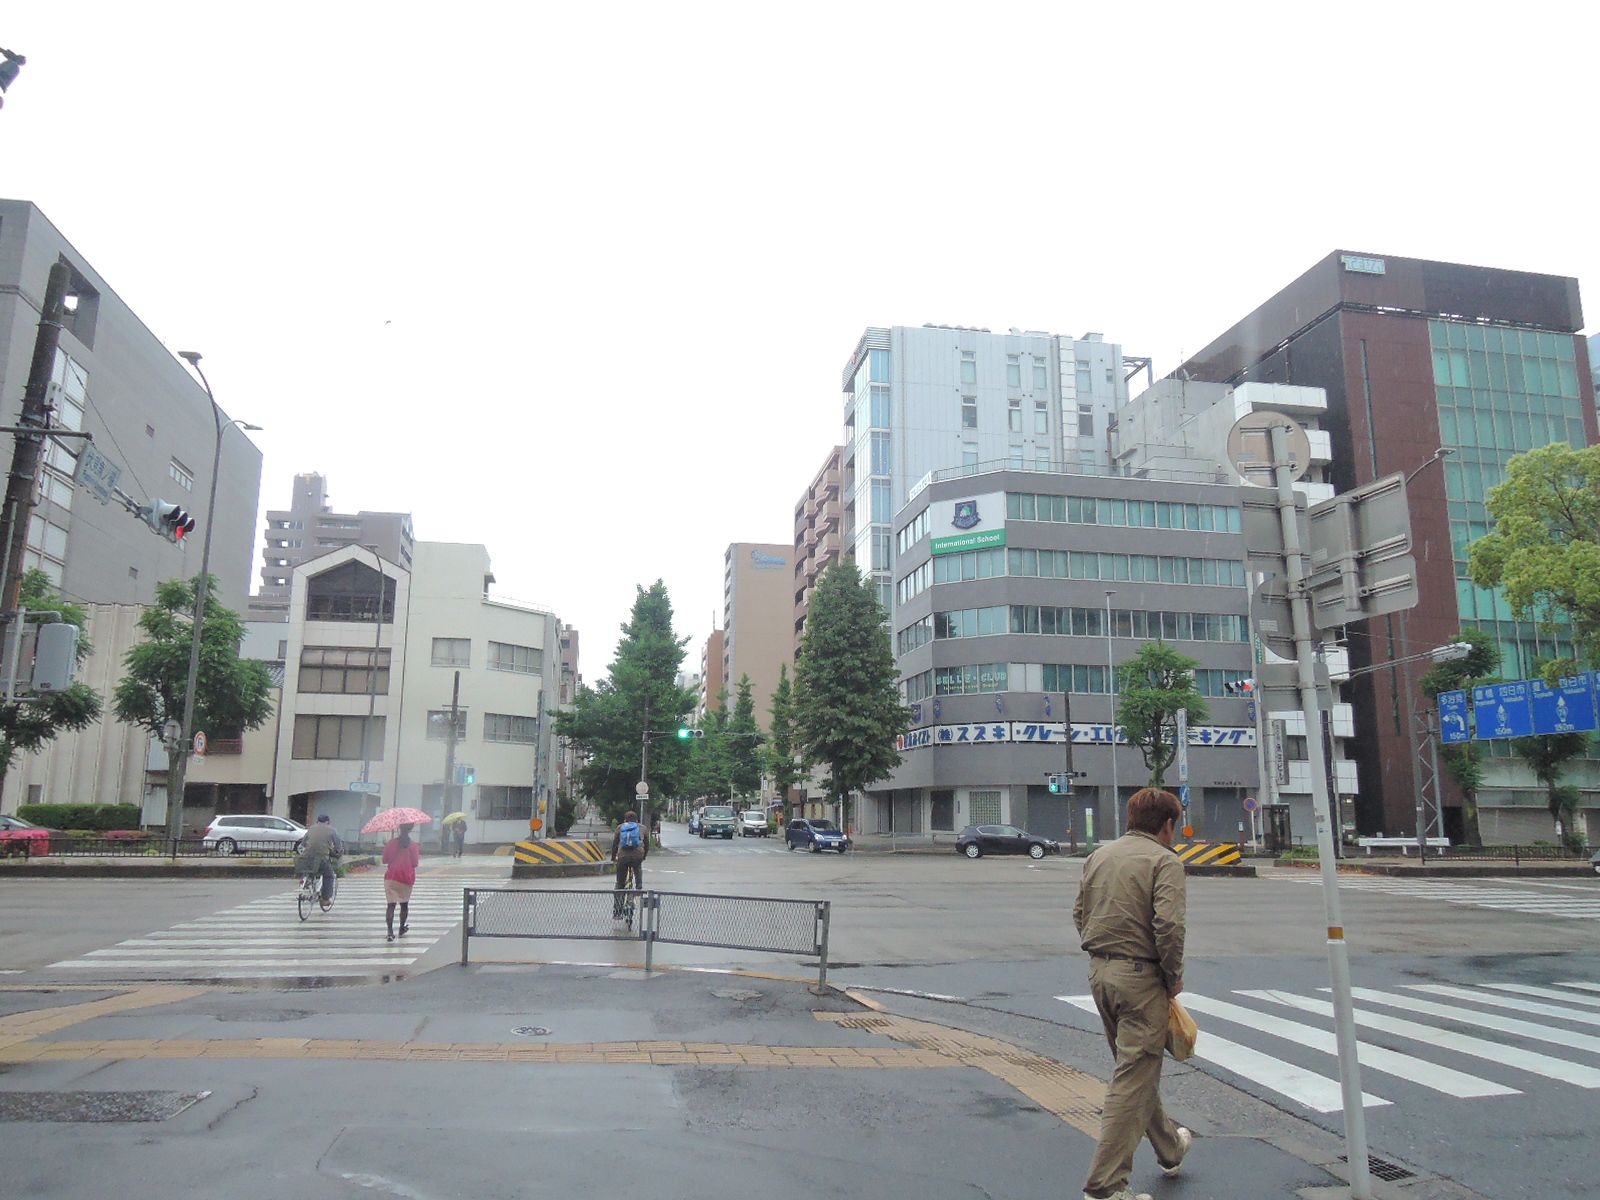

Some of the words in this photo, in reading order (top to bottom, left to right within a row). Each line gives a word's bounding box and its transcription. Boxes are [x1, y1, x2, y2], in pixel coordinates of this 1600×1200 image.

[935, 537, 976, 549] International
[976, 534, 1000, 543] School
[936, 673, 971, 685] BELLE
[981, 671, 1007, 682] CLUB
